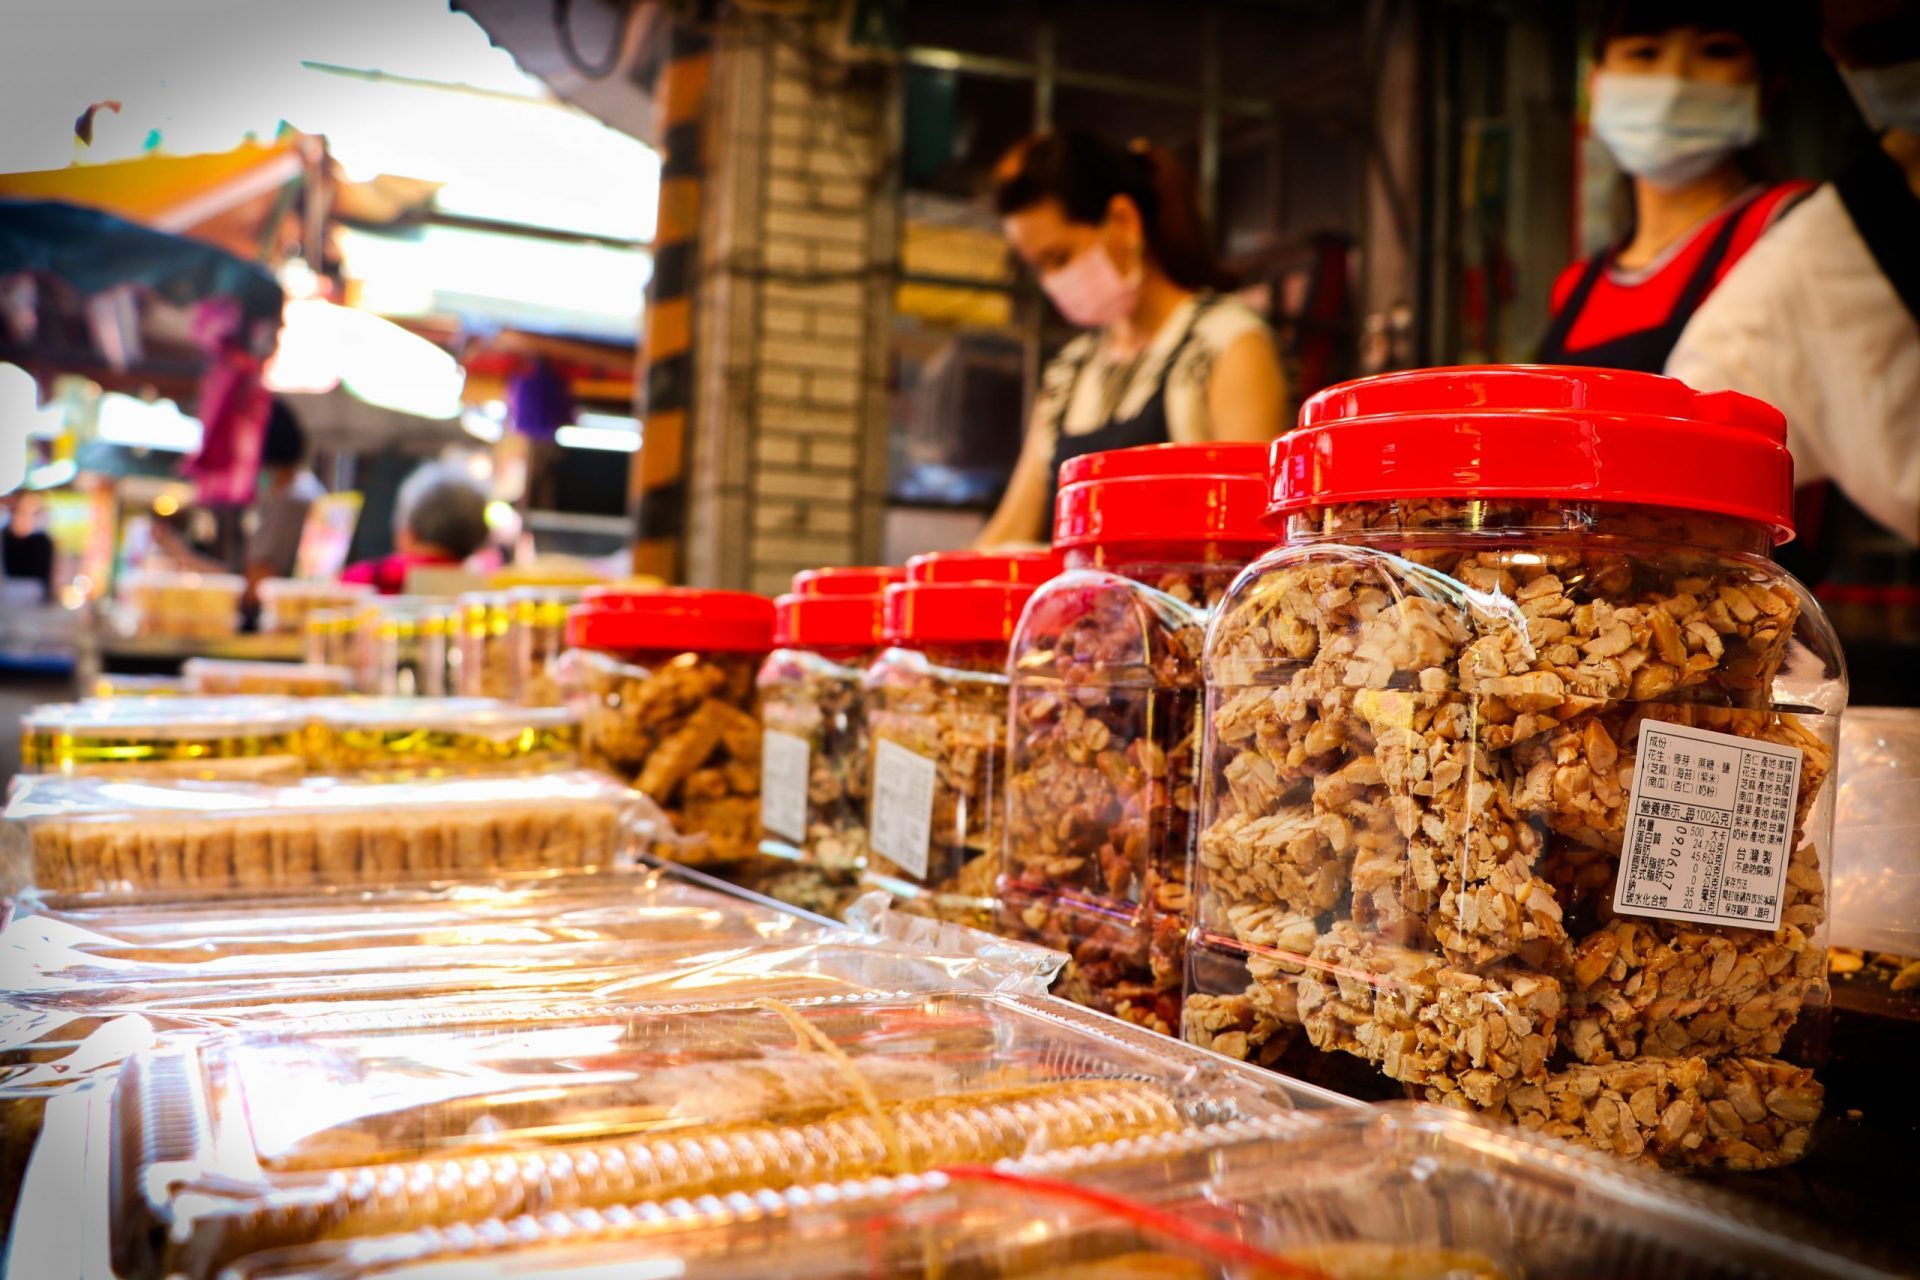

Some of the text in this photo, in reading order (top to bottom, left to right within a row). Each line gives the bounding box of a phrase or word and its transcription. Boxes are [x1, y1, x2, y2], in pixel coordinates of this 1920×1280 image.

[1639, 799, 1680, 818] 營養標示
[1636, 818, 1726, 842] 熱量 500 大卡
[1635, 830, 1661, 845] 蛋白質
[1633, 842, 1650, 855] 脂肪
[1692, 863, 1698, 873] 0
[1704, 864, 1721, 877] 公克
[1690, 875, 1696, 885] 0
[1702, 876, 1719, 889] 公克
[1684, 886, 1694, 897] 35
[1625, 891, 1715, 913] 碳水化合物 20 公克
